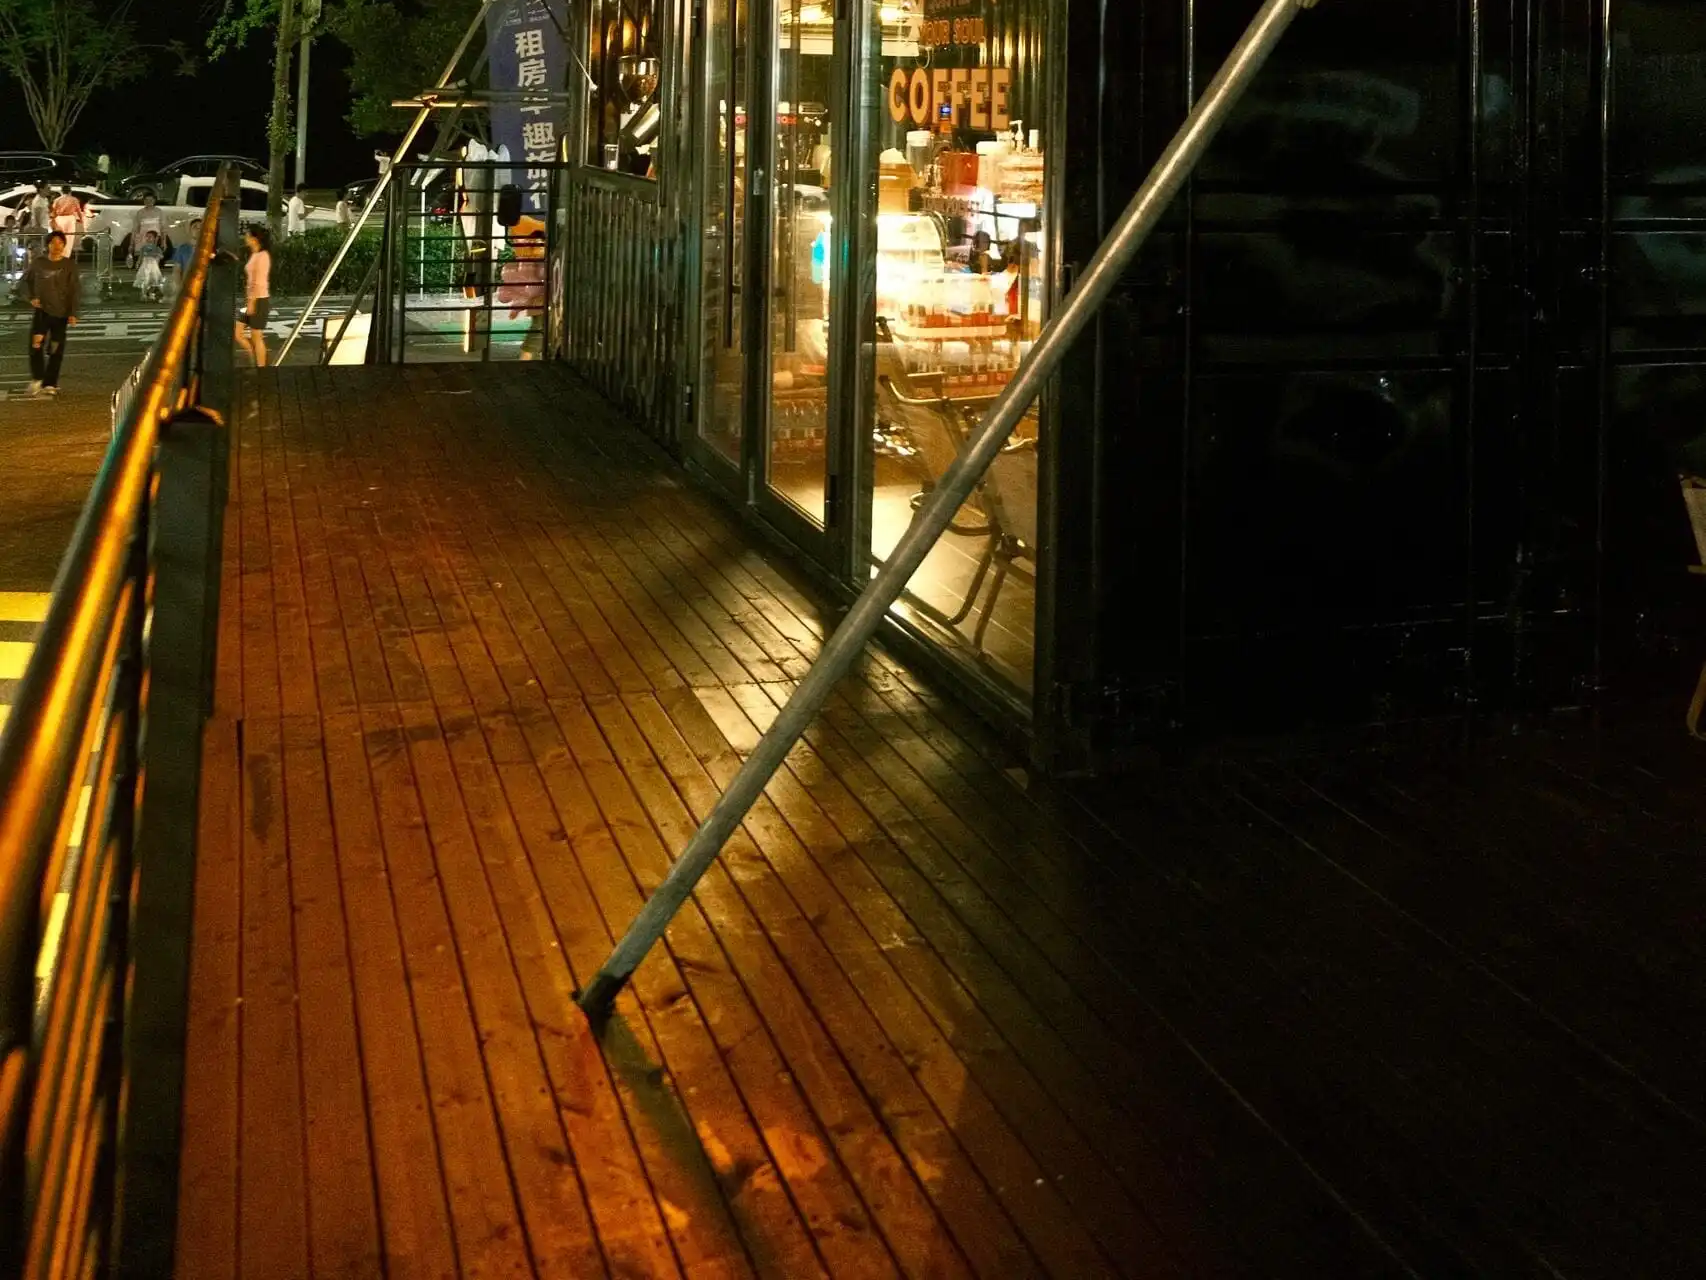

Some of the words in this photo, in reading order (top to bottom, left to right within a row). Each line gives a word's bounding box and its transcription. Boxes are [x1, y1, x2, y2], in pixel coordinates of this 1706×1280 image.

[920, 19, 950, 46] YOUR
[953, 17, 986, 44] SOUL
[888, 68, 1010, 129] COFFEE
